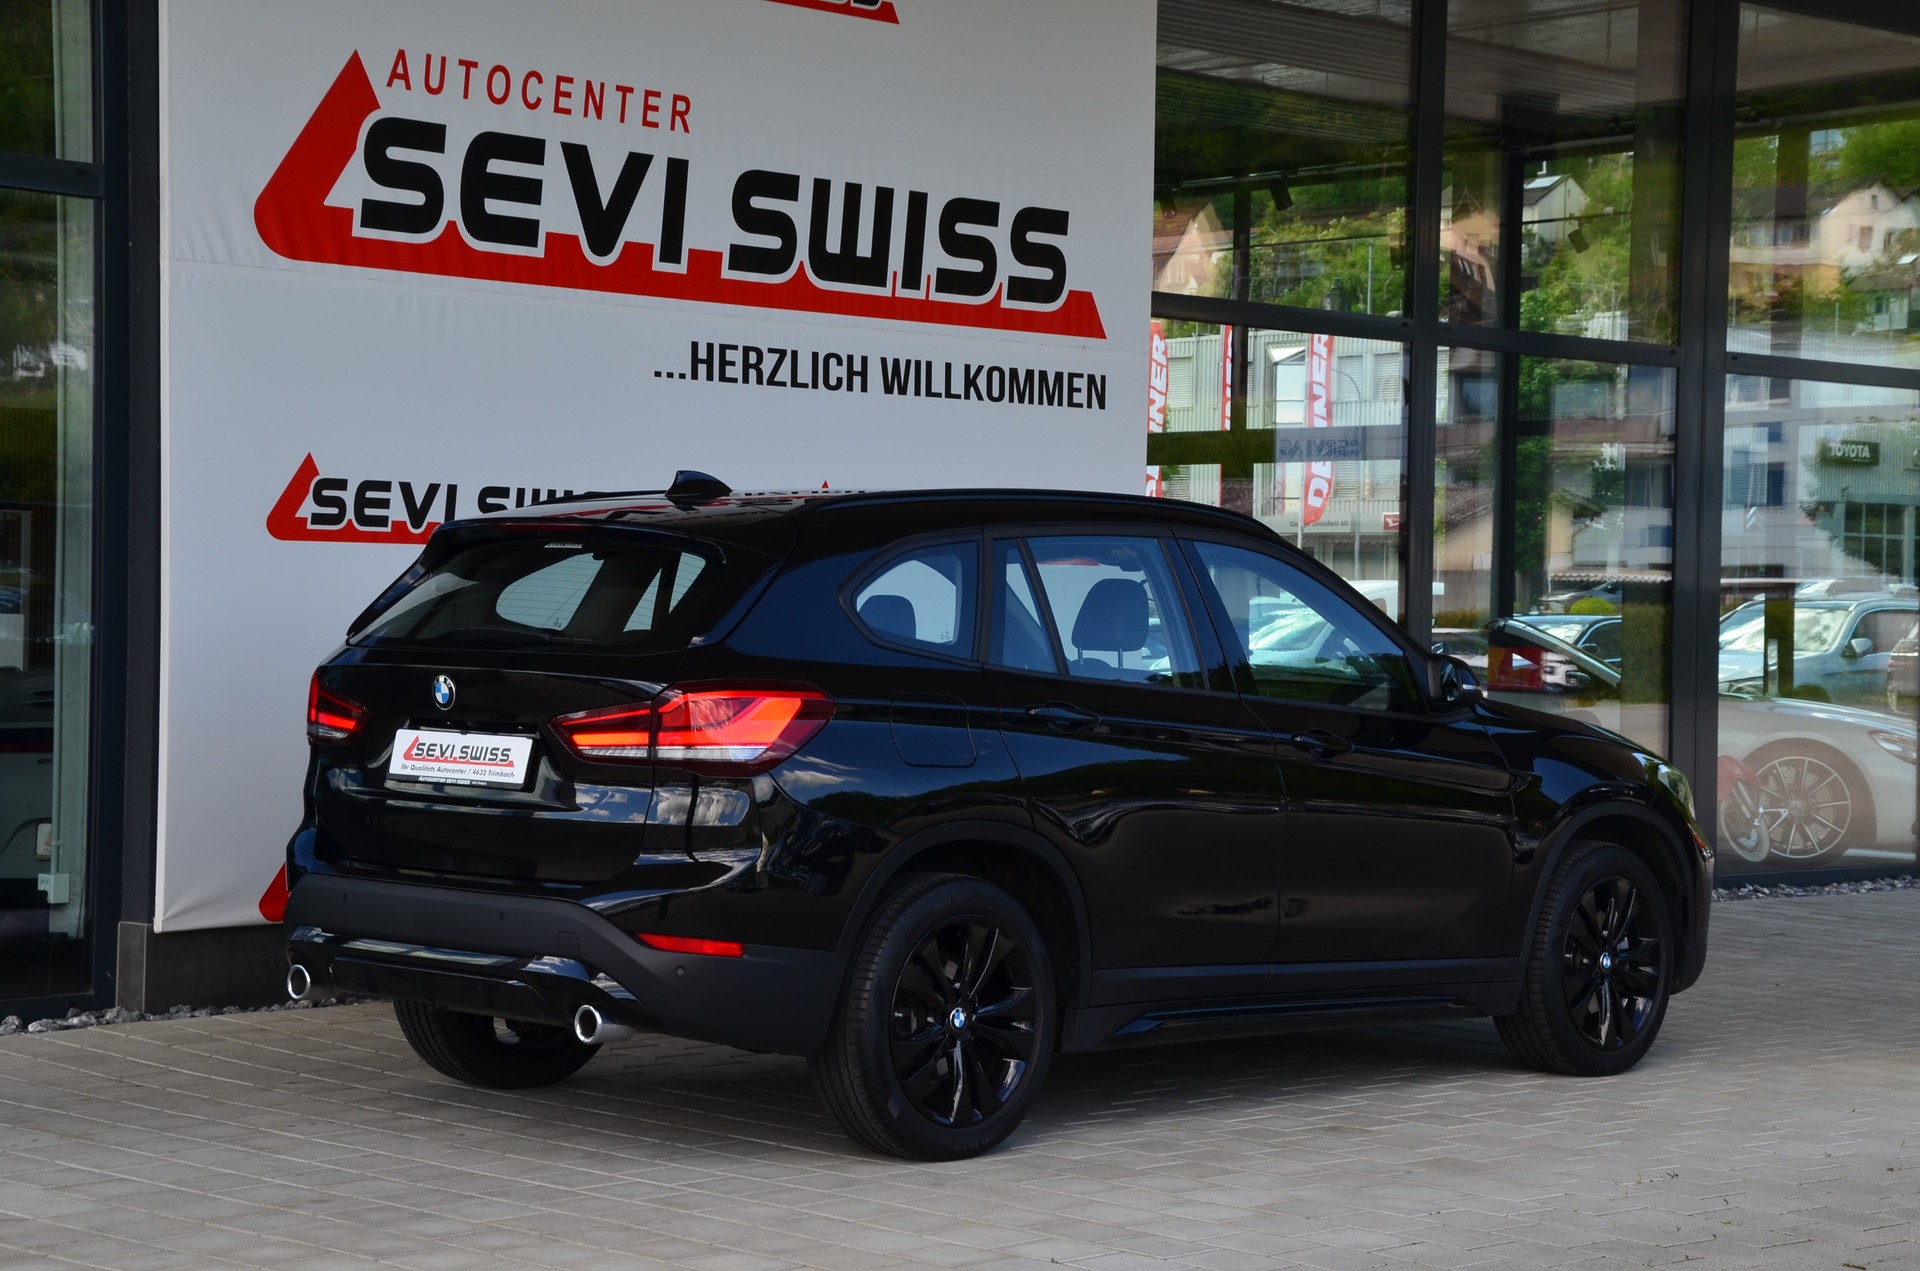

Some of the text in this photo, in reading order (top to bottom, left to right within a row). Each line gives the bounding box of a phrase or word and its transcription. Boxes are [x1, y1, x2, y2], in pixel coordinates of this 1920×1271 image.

[386, 49, 692, 134] AUTOCENTER
[360, 116, 1070, 305] SEVI SWISS
[653, 340, 1107, 411] ...HERZLICH WILLKOMMEN
[1829, 443, 1870, 458] TOYOTA
[310, 478, 458, 529] SEVI
[414, 742, 512, 763] SEVI SWISS
[437, 766, 467, 775] Autocenter
[488, 769, 514, 778] Trimbach
